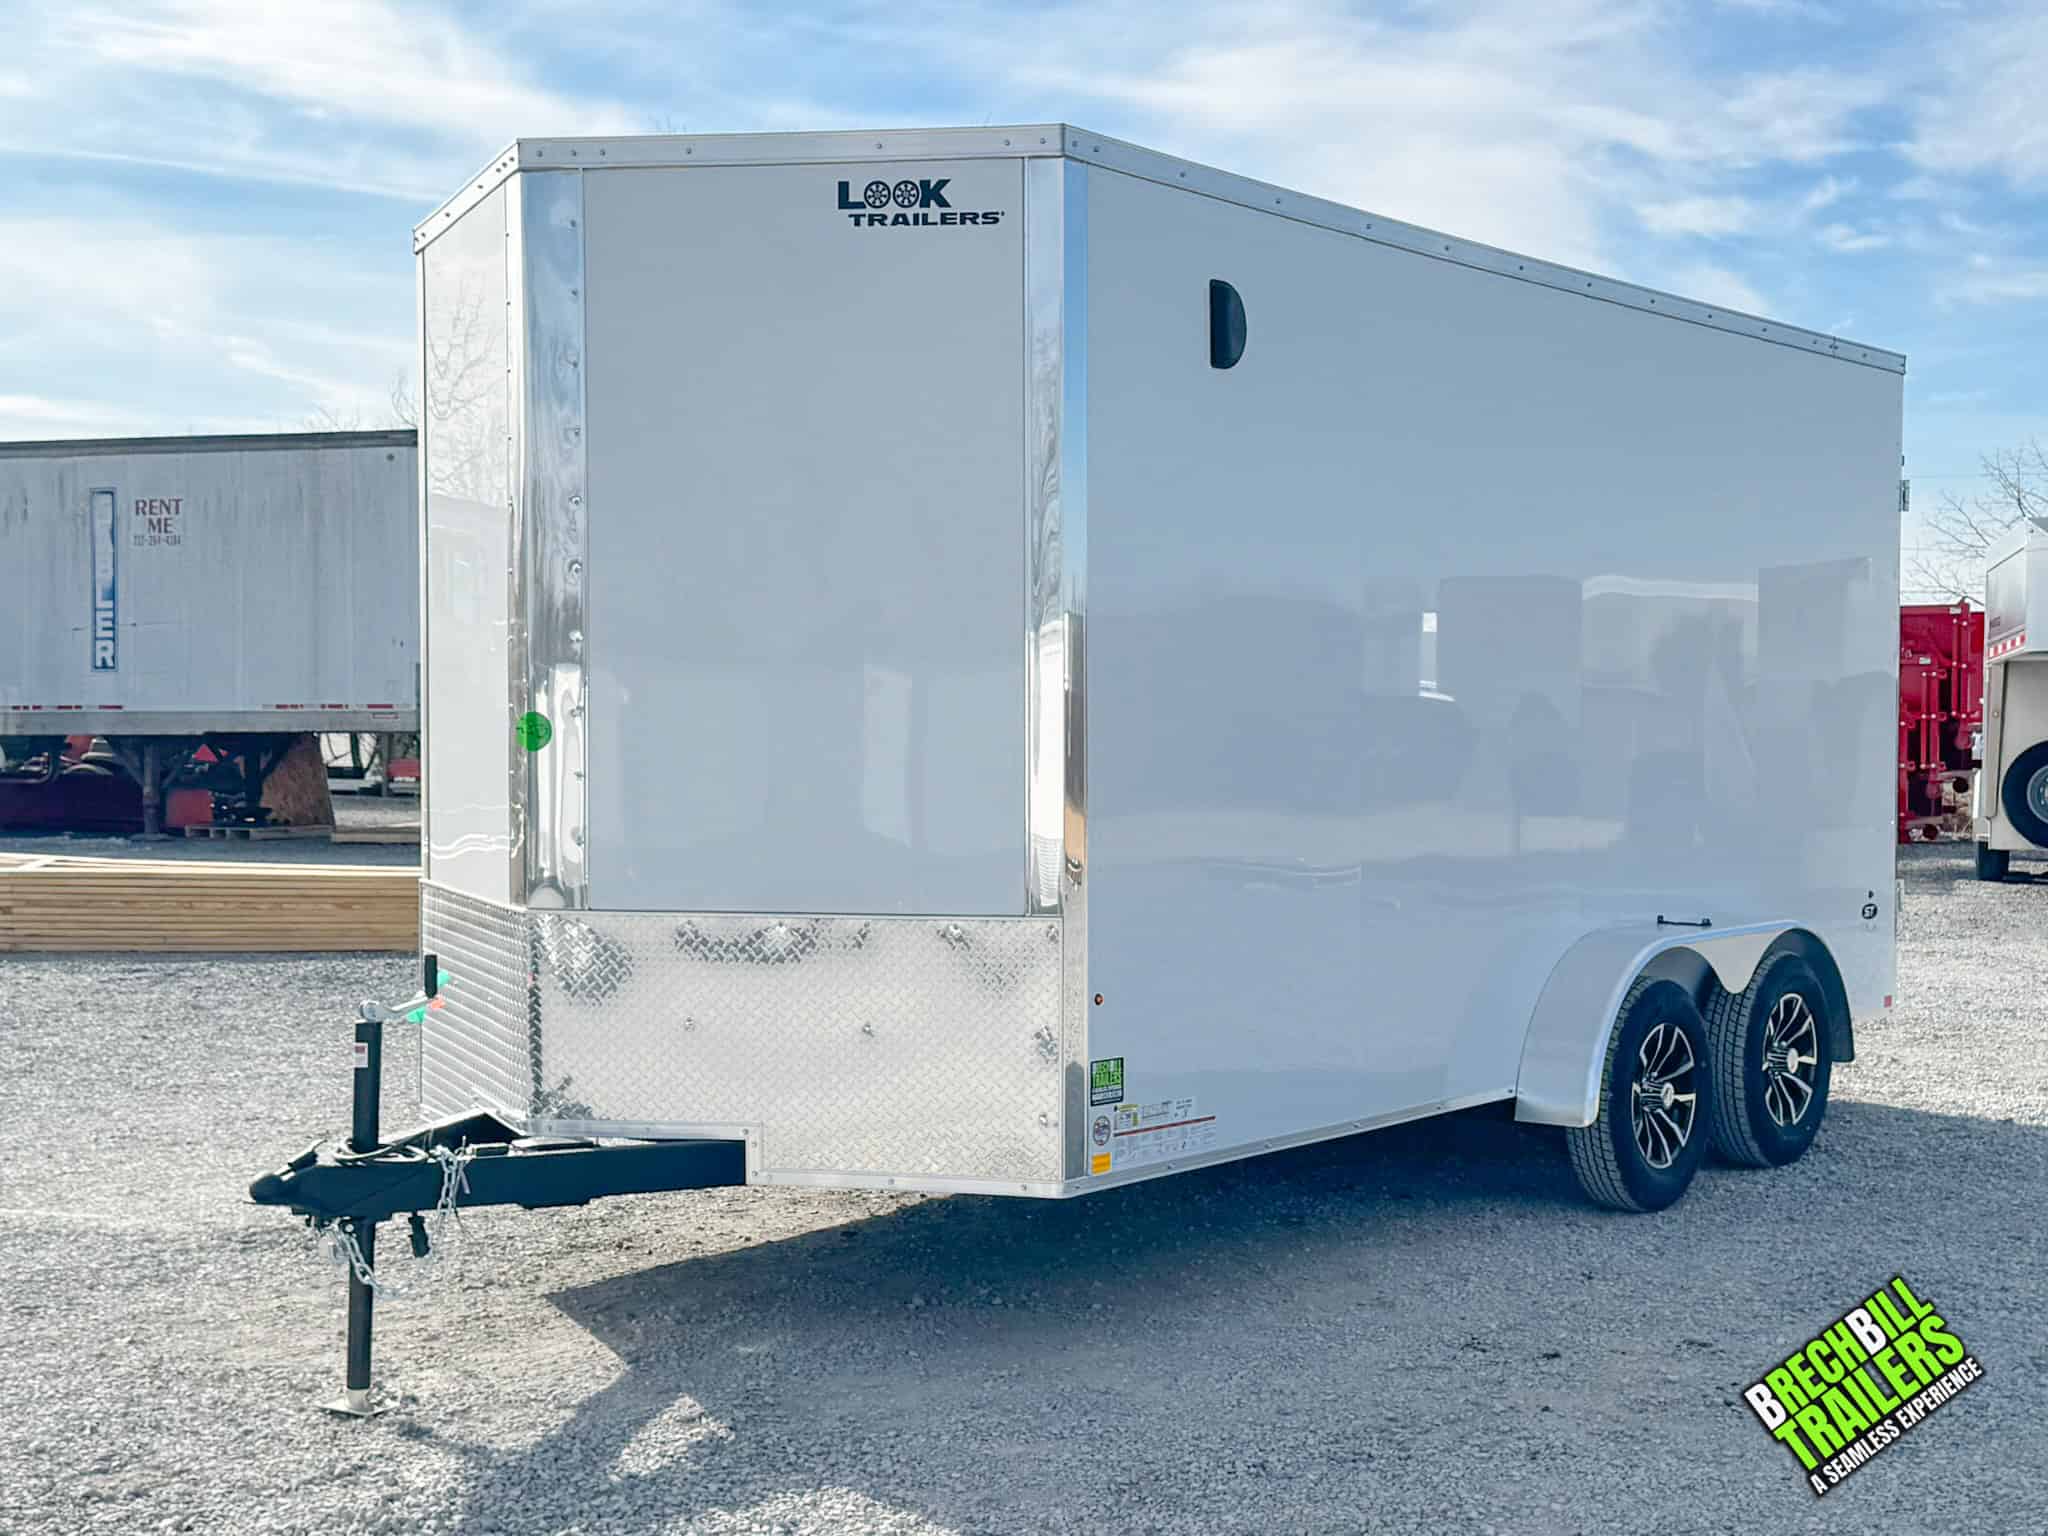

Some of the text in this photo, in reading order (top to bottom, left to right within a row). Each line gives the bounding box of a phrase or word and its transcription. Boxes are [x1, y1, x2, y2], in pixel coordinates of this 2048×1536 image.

[838, 179, 951, 210] LOOK
[848, 212, 1000, 227] TRAILERS
[135, 498, 184, 516] RENT
[148, 517, 176, 534] ME
